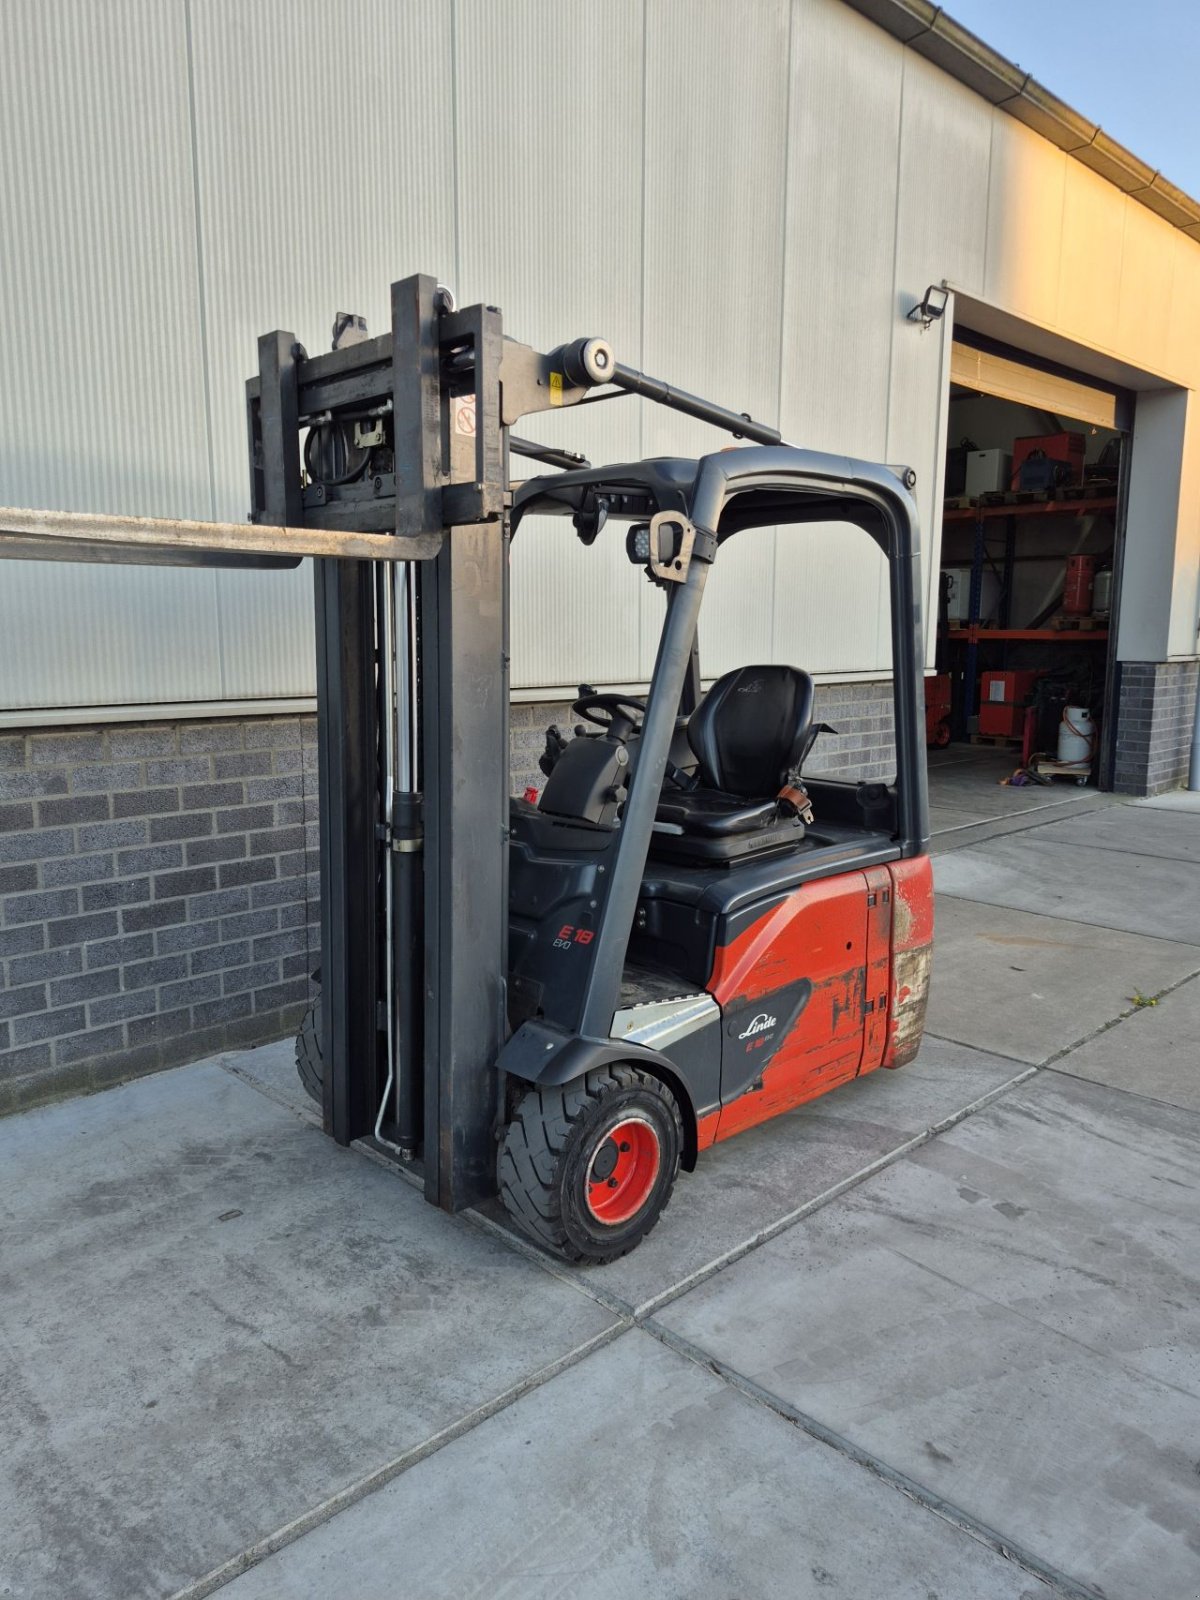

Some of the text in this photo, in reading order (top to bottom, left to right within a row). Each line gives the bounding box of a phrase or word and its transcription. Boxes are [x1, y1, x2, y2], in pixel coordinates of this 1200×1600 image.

[552, 938, 572, 950] EVO
[558, 924, 594, 945] E 18
[738, 1013, 777, 1039] Linde
